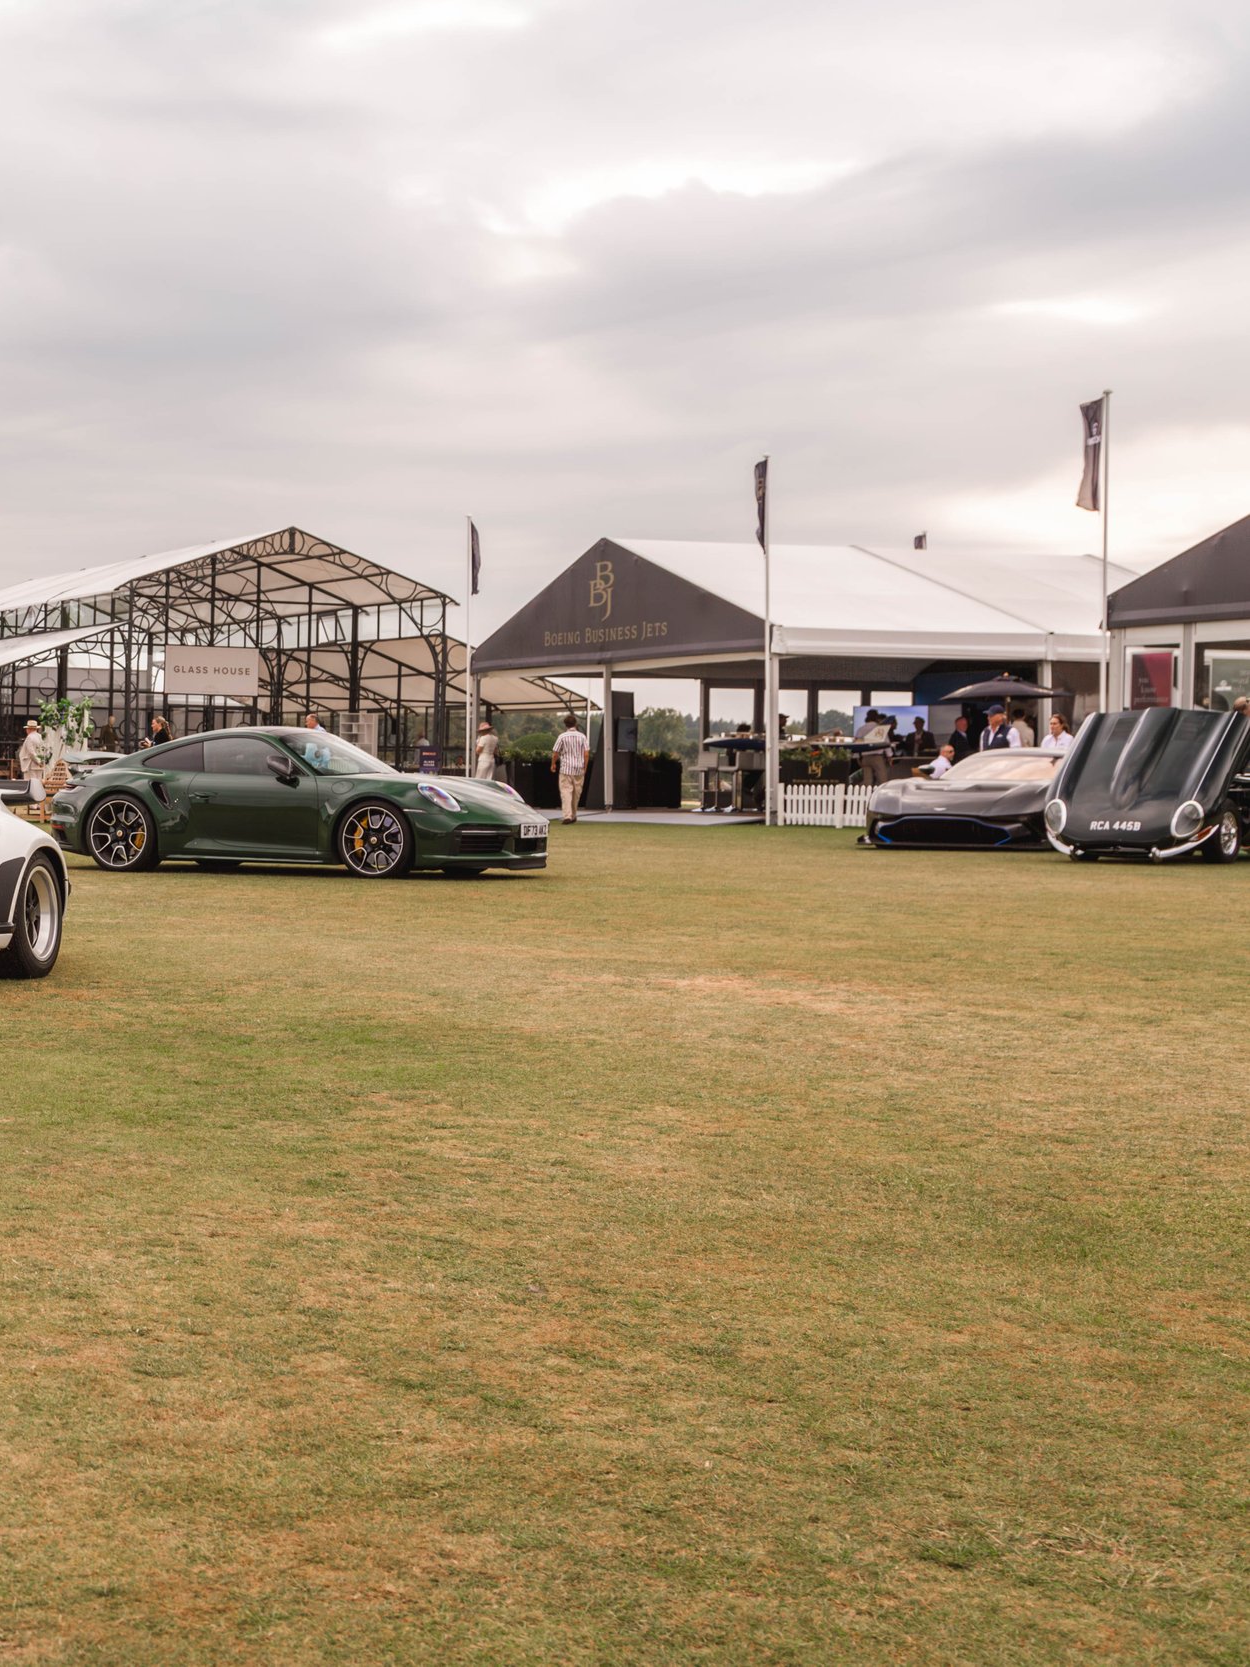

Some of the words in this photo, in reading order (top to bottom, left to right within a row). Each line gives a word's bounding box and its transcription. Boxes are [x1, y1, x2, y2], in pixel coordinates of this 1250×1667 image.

[544, 631, 581, 647] BOEING
[585, 625, 638, 644] BUSINESS
[641, 621, 668, 641] JETS
[173, 665, 209, 674] GLASS
[213, 666, 251, 676] HOUSE
[1089, 820, 1110, 831] RCA
[1112, 820, 1142, 831] 445B
